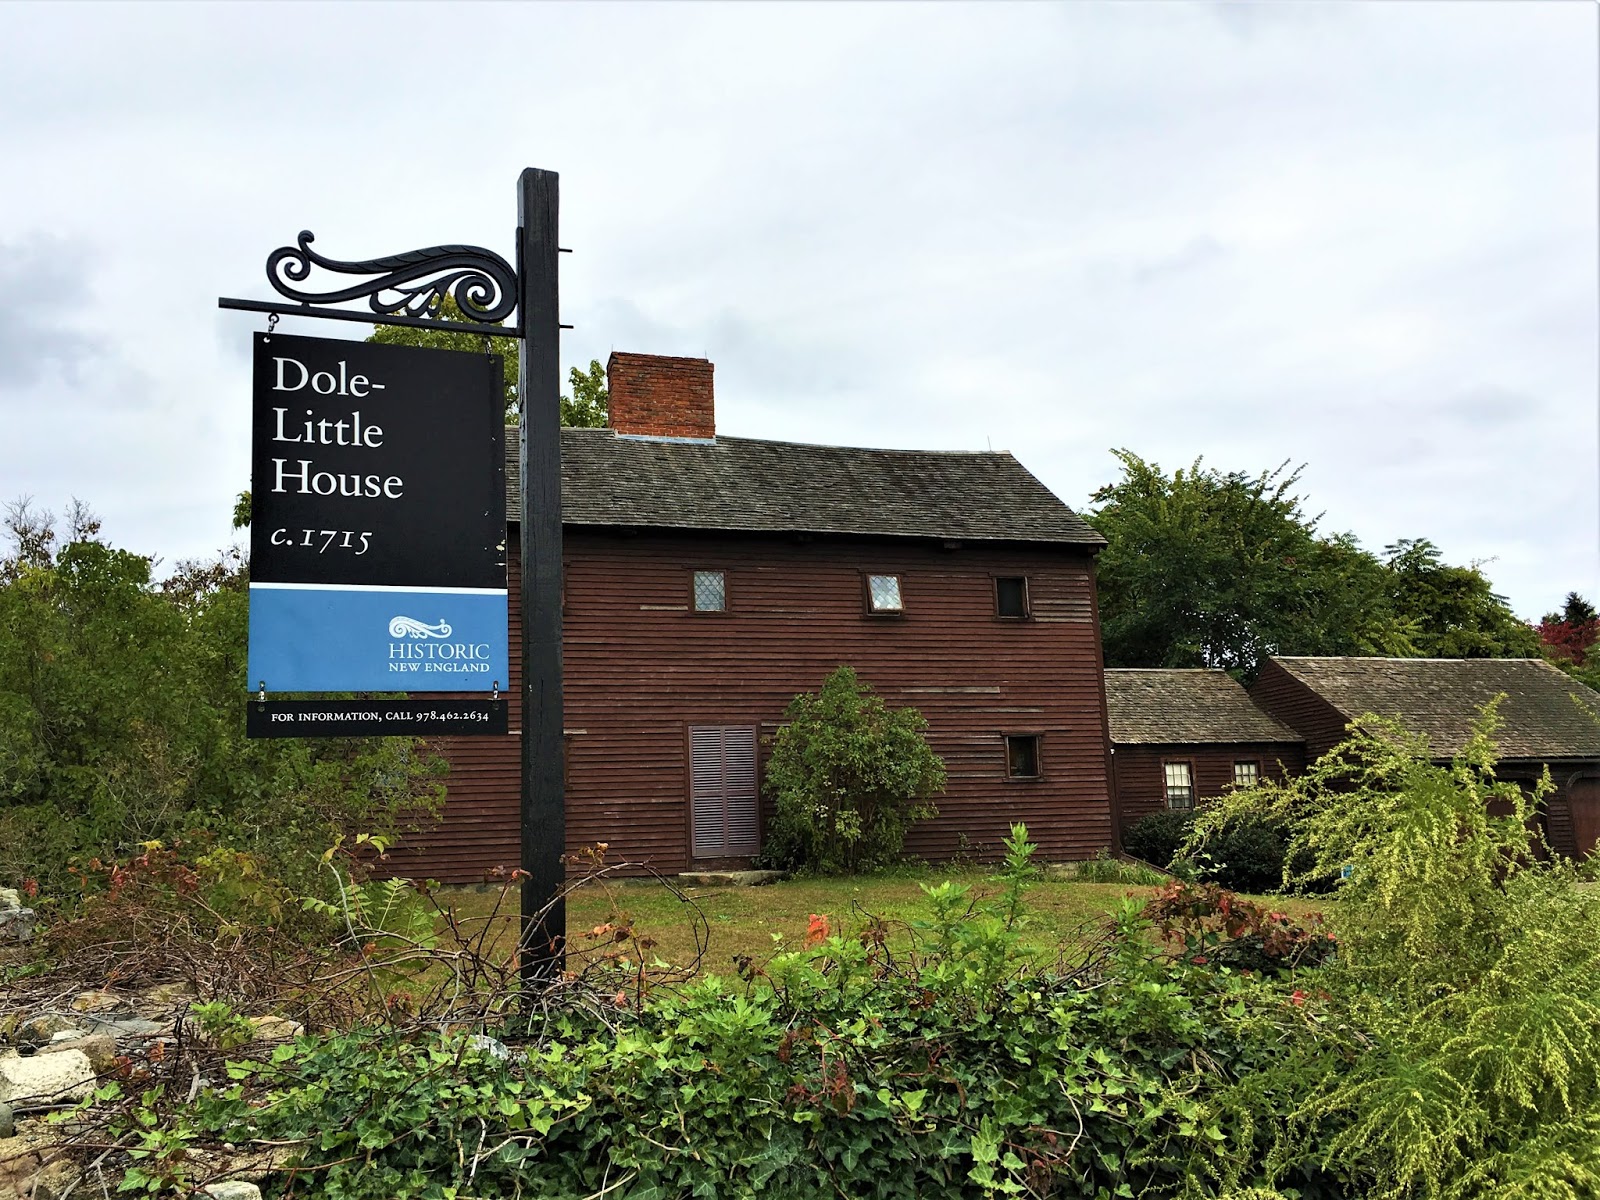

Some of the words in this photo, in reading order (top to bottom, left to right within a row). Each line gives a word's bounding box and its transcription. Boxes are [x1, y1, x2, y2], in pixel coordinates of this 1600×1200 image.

[272, 356, 386, 398] Dole-
[272, 407, 384, 448] Little
[271, 458, 404, 499] House
[388, 642, 490, 660] HISTORIC
[388, 662, 422, 672] NEW
[424, 662, 490, 673] ENGLAND
[271, 713, 295, 722] FOR
[298, 711, 383, 723] INFORMATION,
[385, 711, 414, 721] CALL
[415, 710, 489, 723] 978.462.2634
